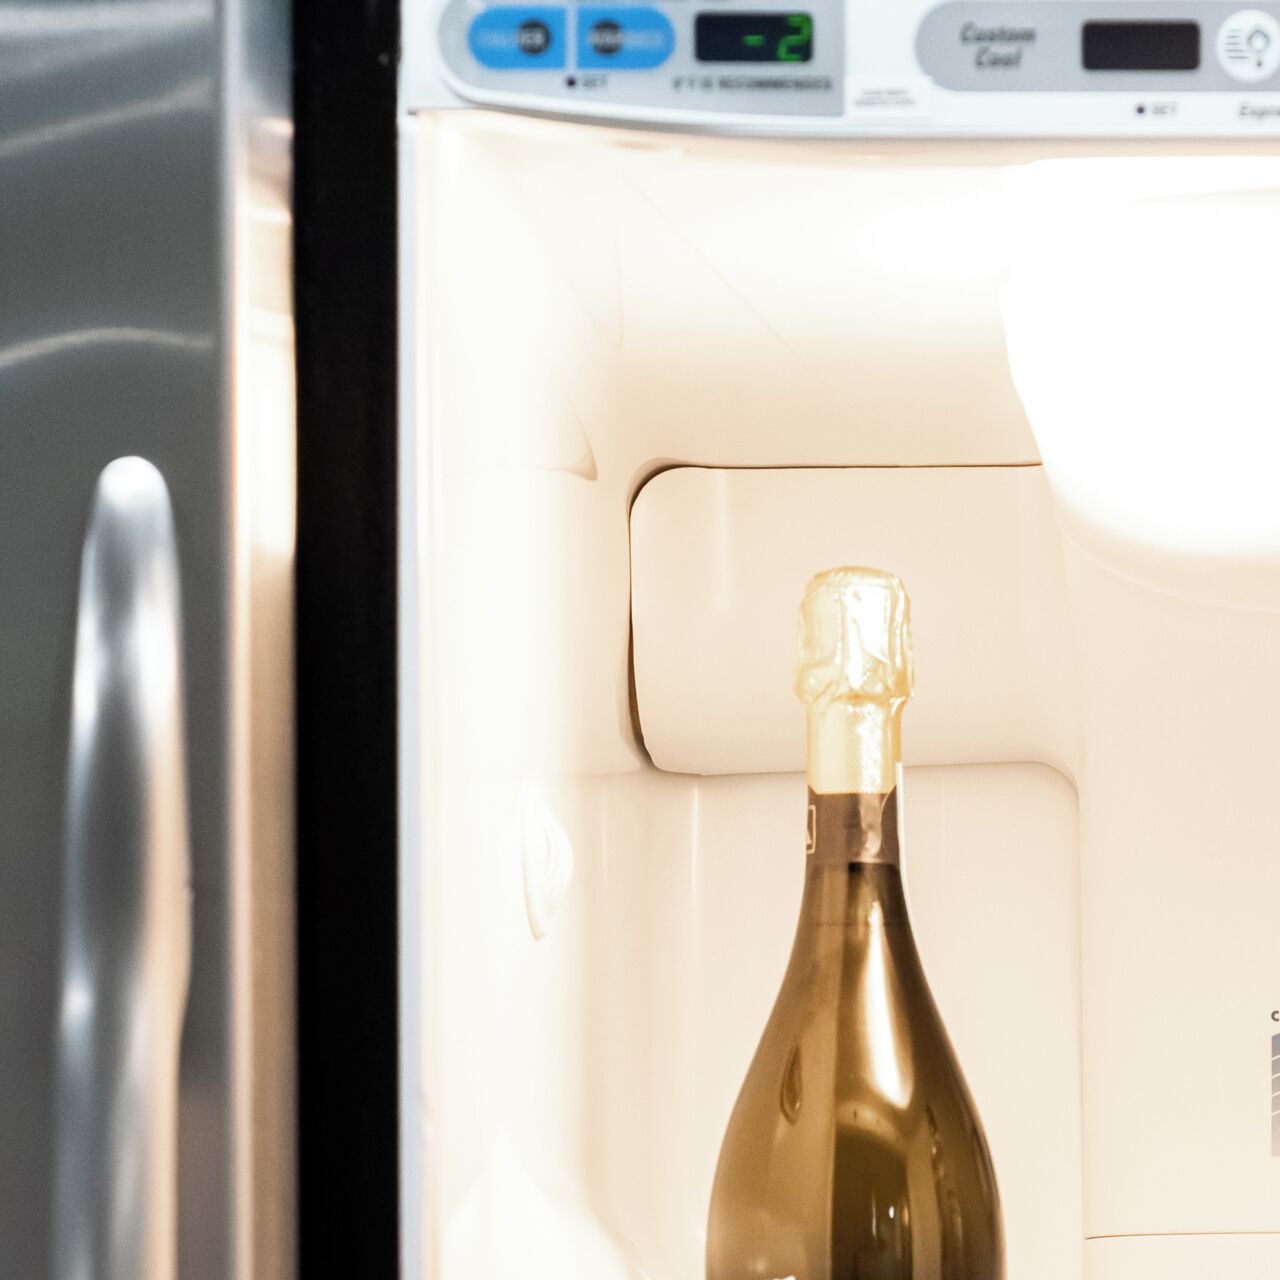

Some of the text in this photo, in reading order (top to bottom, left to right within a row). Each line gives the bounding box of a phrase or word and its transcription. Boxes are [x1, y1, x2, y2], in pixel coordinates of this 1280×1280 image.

[742, 13, 813, 62] -2
[960, 22, 1036, 45] Custom
[974, 47, 1022, 69] Cool
